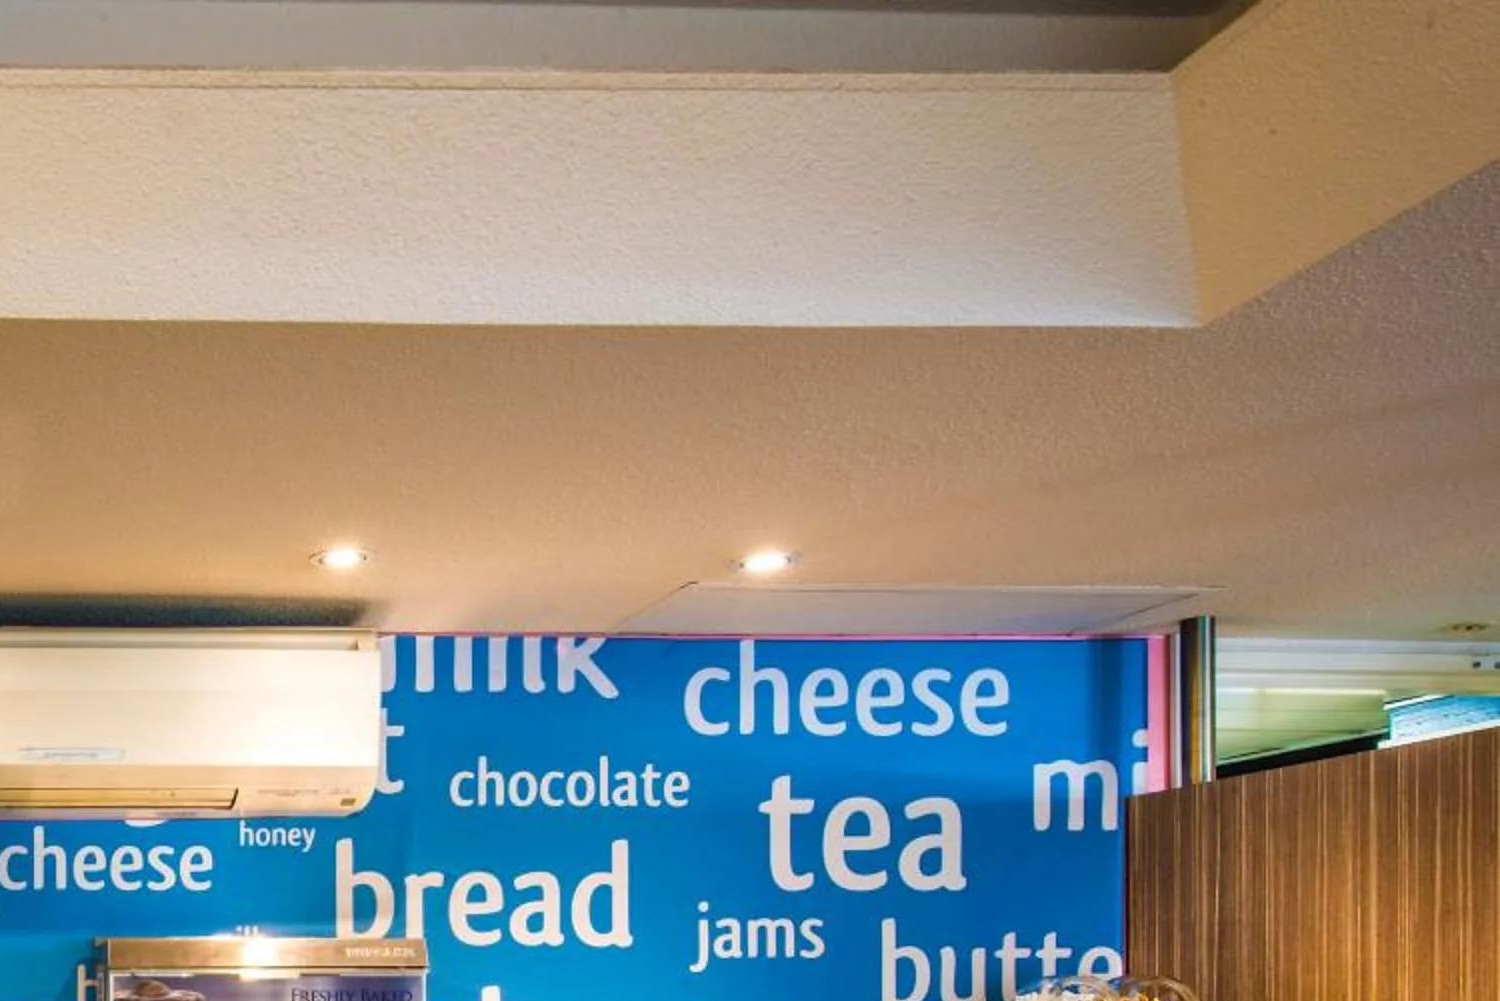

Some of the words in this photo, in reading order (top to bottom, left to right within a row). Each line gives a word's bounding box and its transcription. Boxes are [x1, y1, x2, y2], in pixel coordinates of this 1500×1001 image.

[683, 640, 1009, 736] cheese
[449, 755, 691, 808] chocolate
[239, 819, 317, 852] honey
[758, 775, 967, 892] tea
[335, 837, 634, 948] bread
[689, 902, 826, 972] jams
